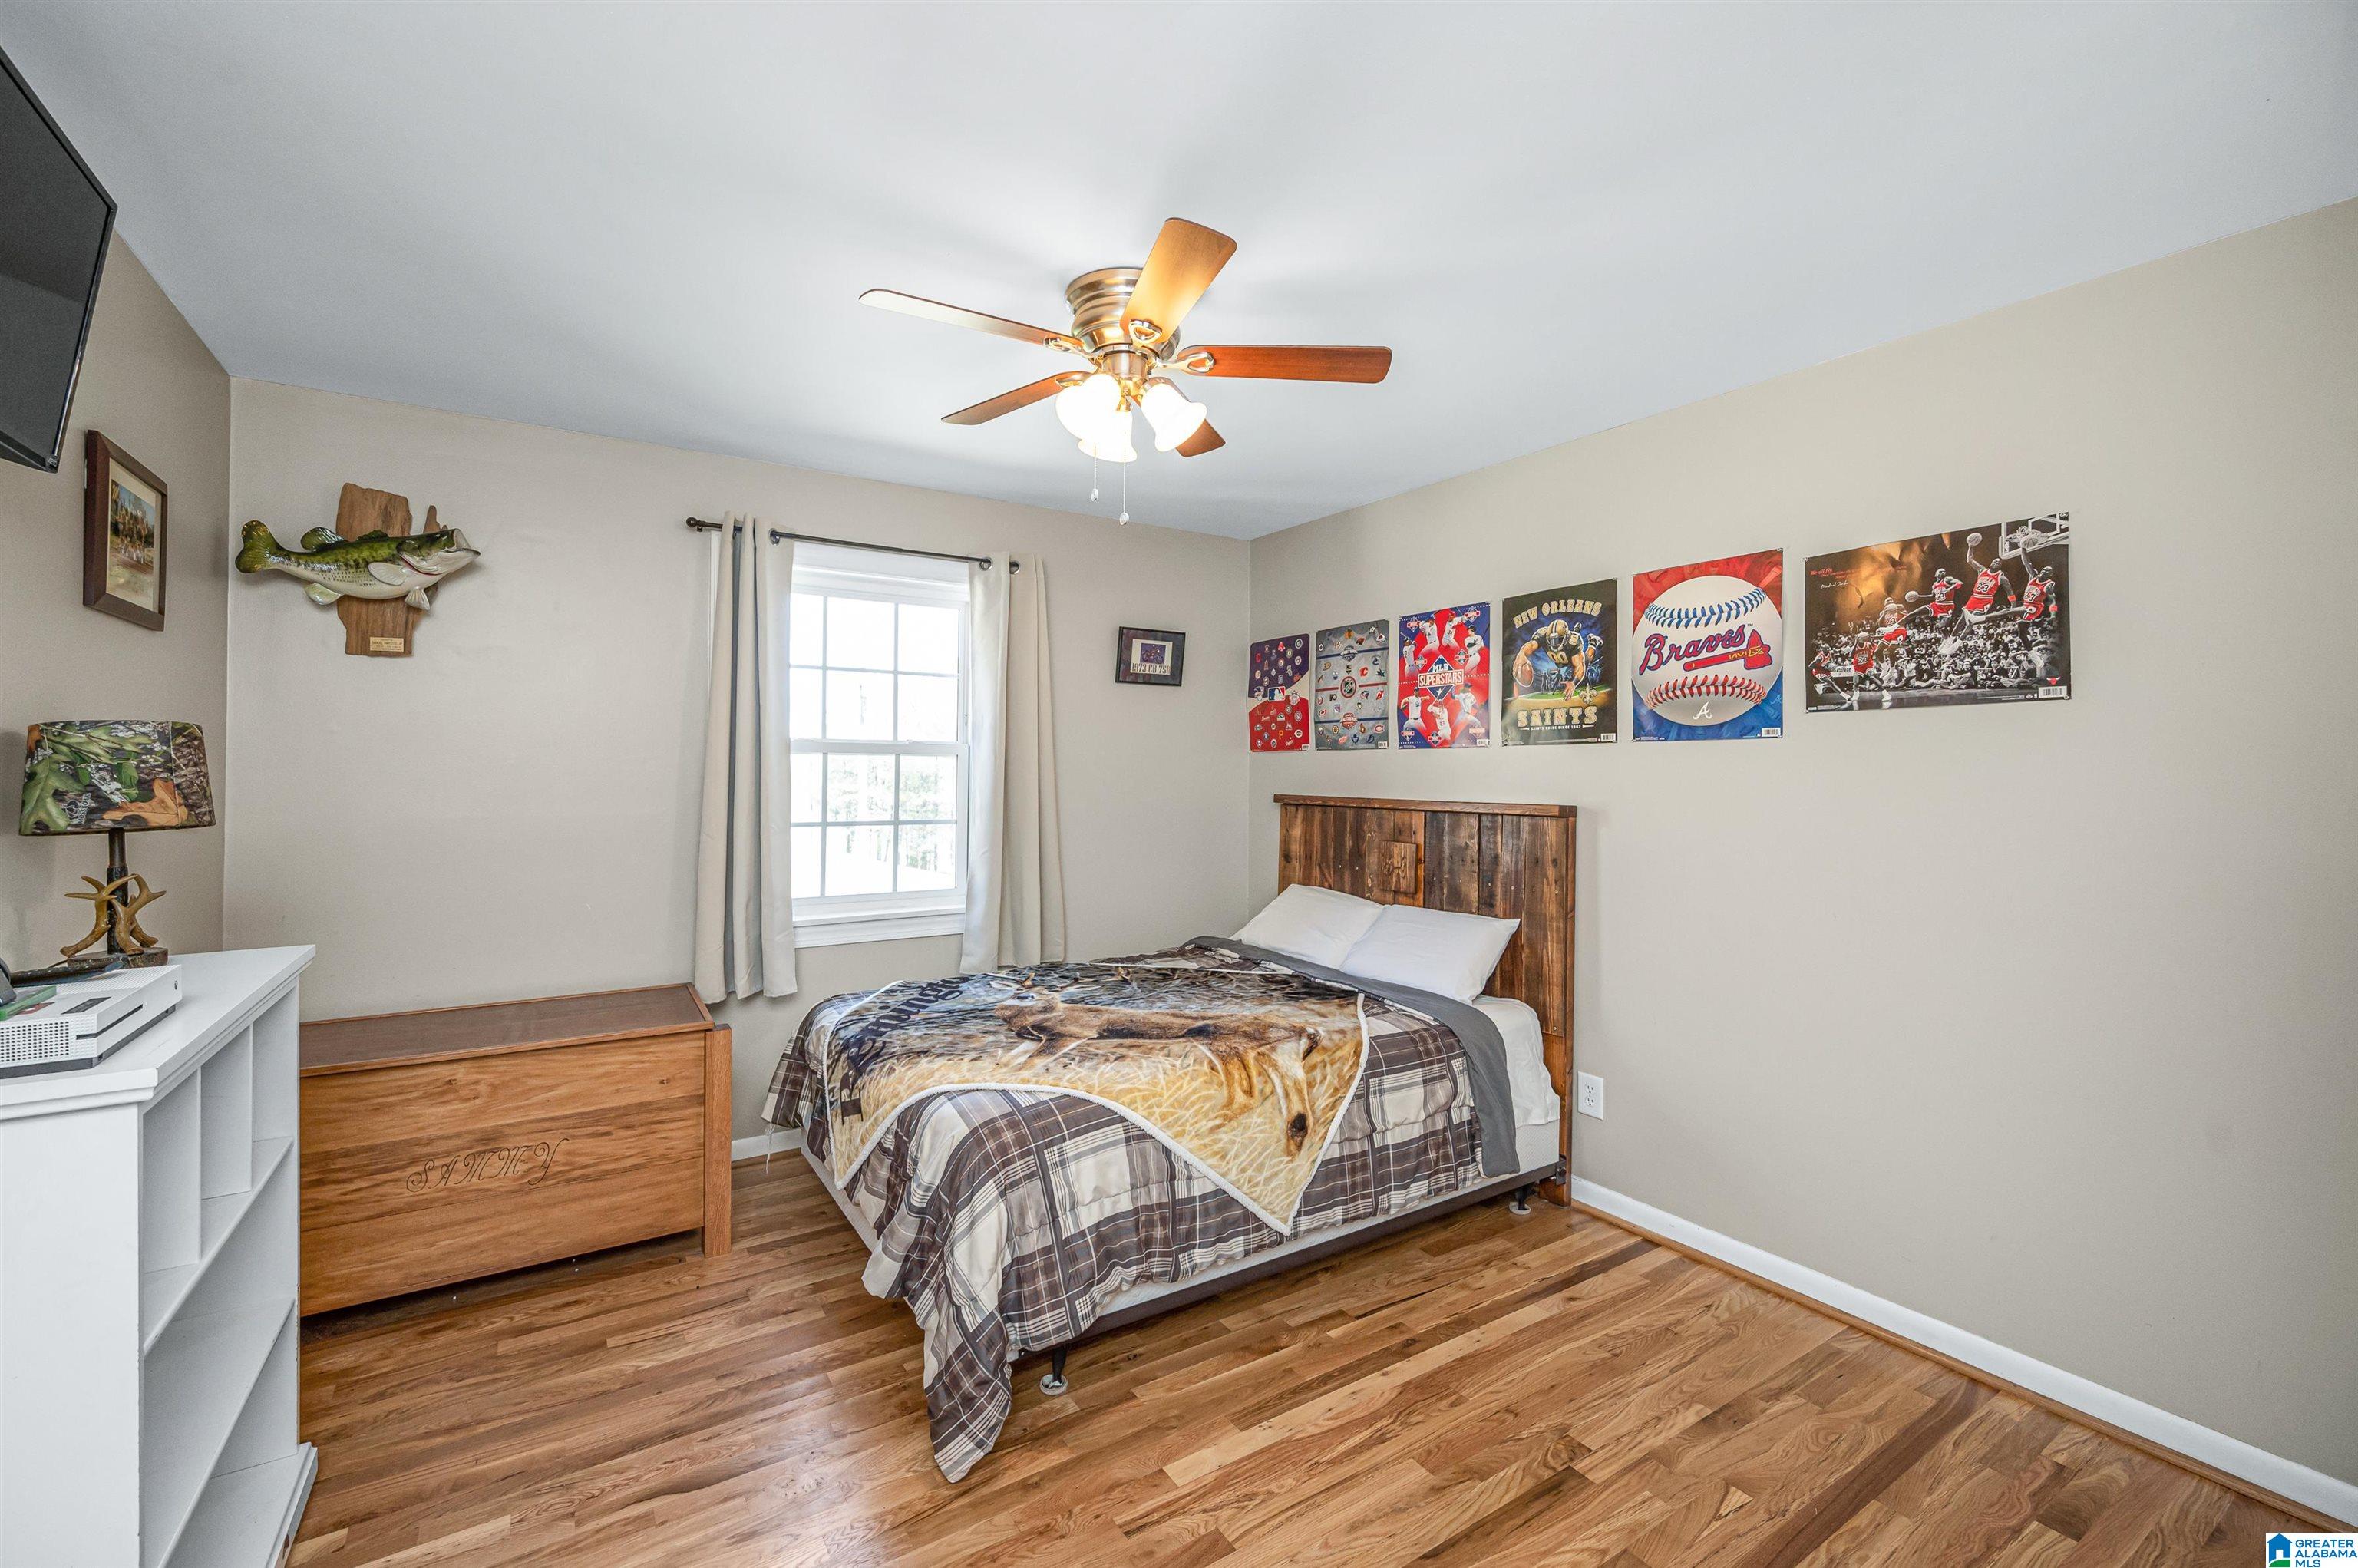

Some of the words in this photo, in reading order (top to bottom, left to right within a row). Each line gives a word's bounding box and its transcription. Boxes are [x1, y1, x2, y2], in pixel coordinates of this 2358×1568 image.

[1513, 606, 1537, 629] NEW
[1541, 599, 1602, 616] ORLEANS
[1639, 623, 1746, 676] Braves
[1418, 672, 1462, 687] SUPERSTARS
[1432, 663, 1449, 673] MLB
[1517, 705, 1597, 728] SAINTS
